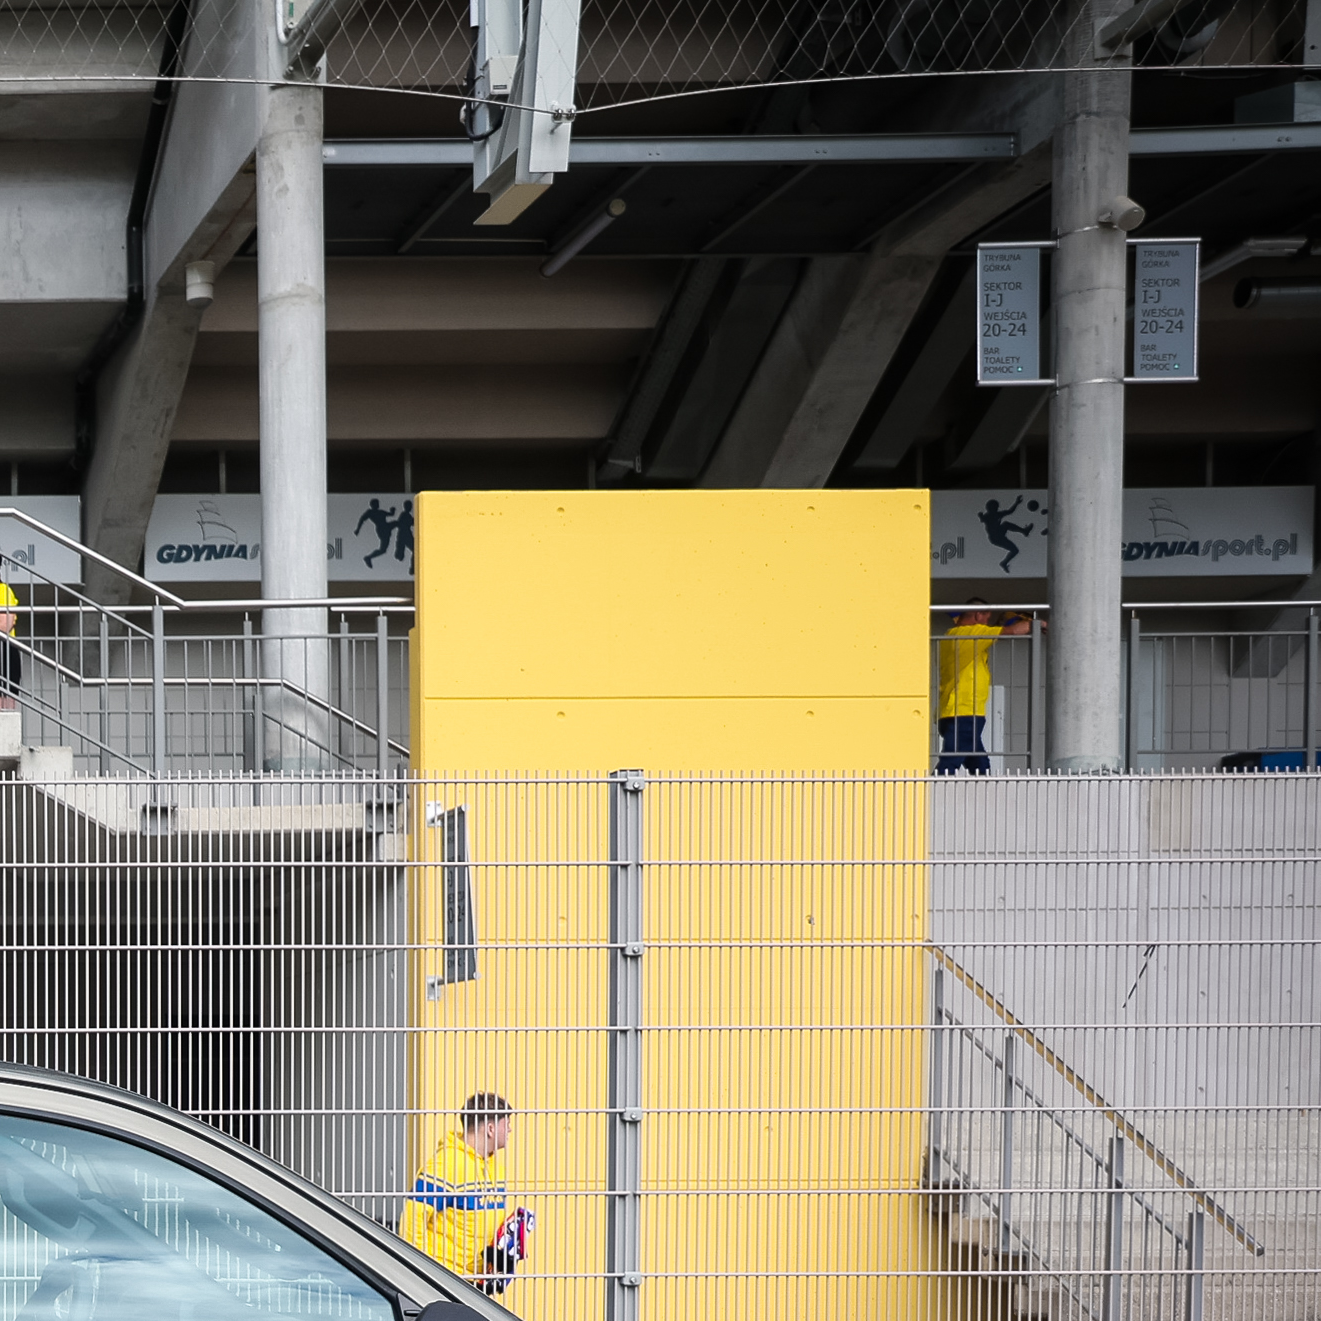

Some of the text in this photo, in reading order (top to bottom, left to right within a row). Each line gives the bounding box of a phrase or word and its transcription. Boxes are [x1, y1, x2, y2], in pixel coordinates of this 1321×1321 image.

[984, 254, 1021, 262] TRYBUNA
[1142, 250, 1180, 258] TRYBUNA
[983, 263, 1011, 272] GÓRKA
[1142, 258, 1170, 268] GÓRKA
[983, 282, 1022, 291] SEKTOR
[1141, 278, 1180, 288] SEKTOR
[984, 308, 1027, 320] WEJŚCIA
[1141, 306, 1185, 318] WEJŚCIA
[982, 322, 1027, 337] 20-24
[1140, 319, 1184, 334] 20-24
[1140, 344, 1156, 352] BAR
[984, 356, 1020, 364] TOALETY
[1141, 354, 1177, 362] TOALETY
[983, 366, 1014, 374] POMOC
[1140, 363, 1170, 371] POMOC
